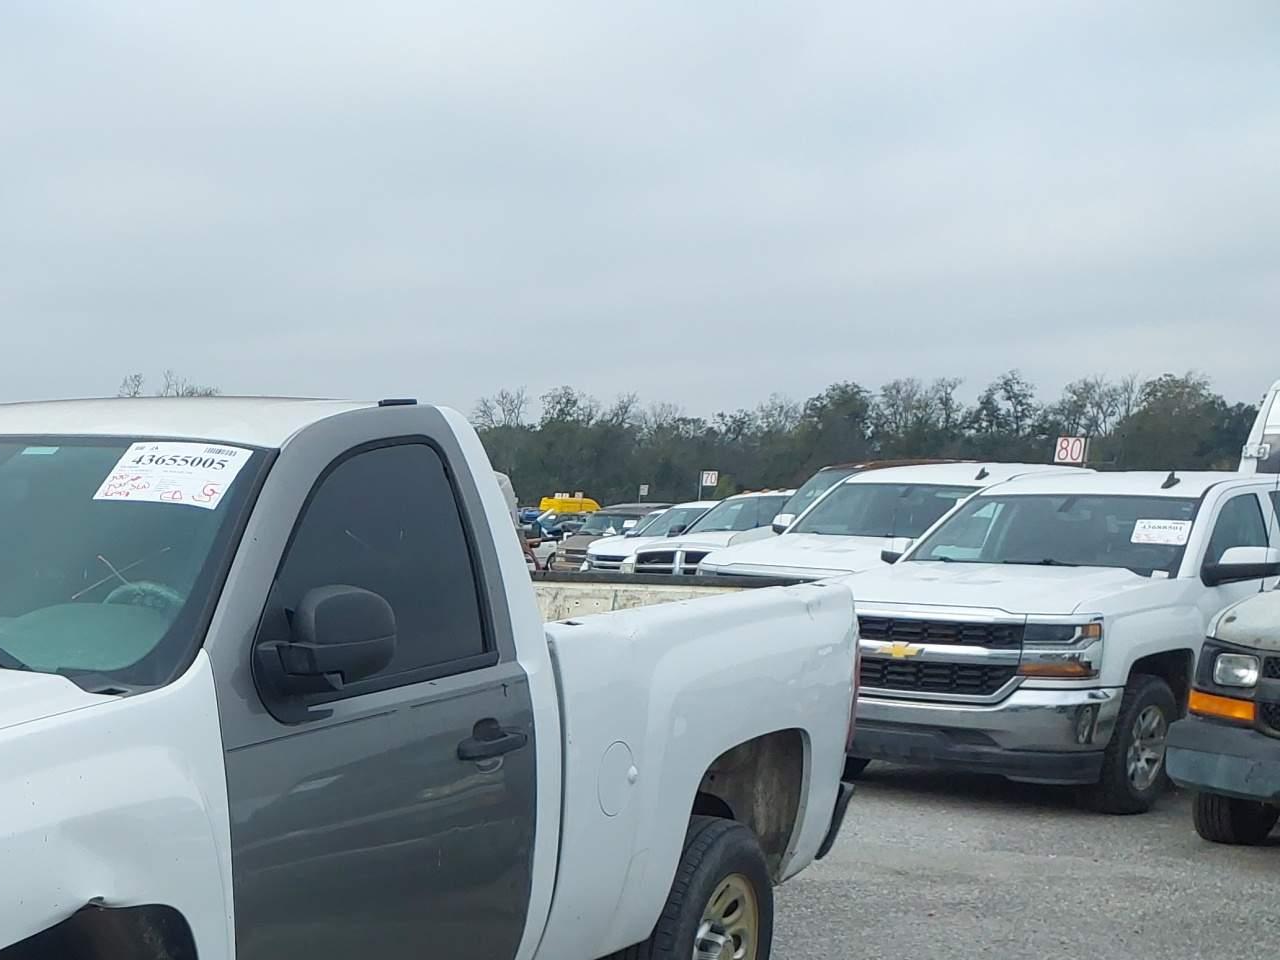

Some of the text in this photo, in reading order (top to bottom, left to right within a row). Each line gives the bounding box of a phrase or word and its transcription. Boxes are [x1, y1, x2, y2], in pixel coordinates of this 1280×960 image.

[1057, 438, 1082, 461] 80
[131, 454, 228, 471] 43655005
[704, 472, 717, 485] 70
